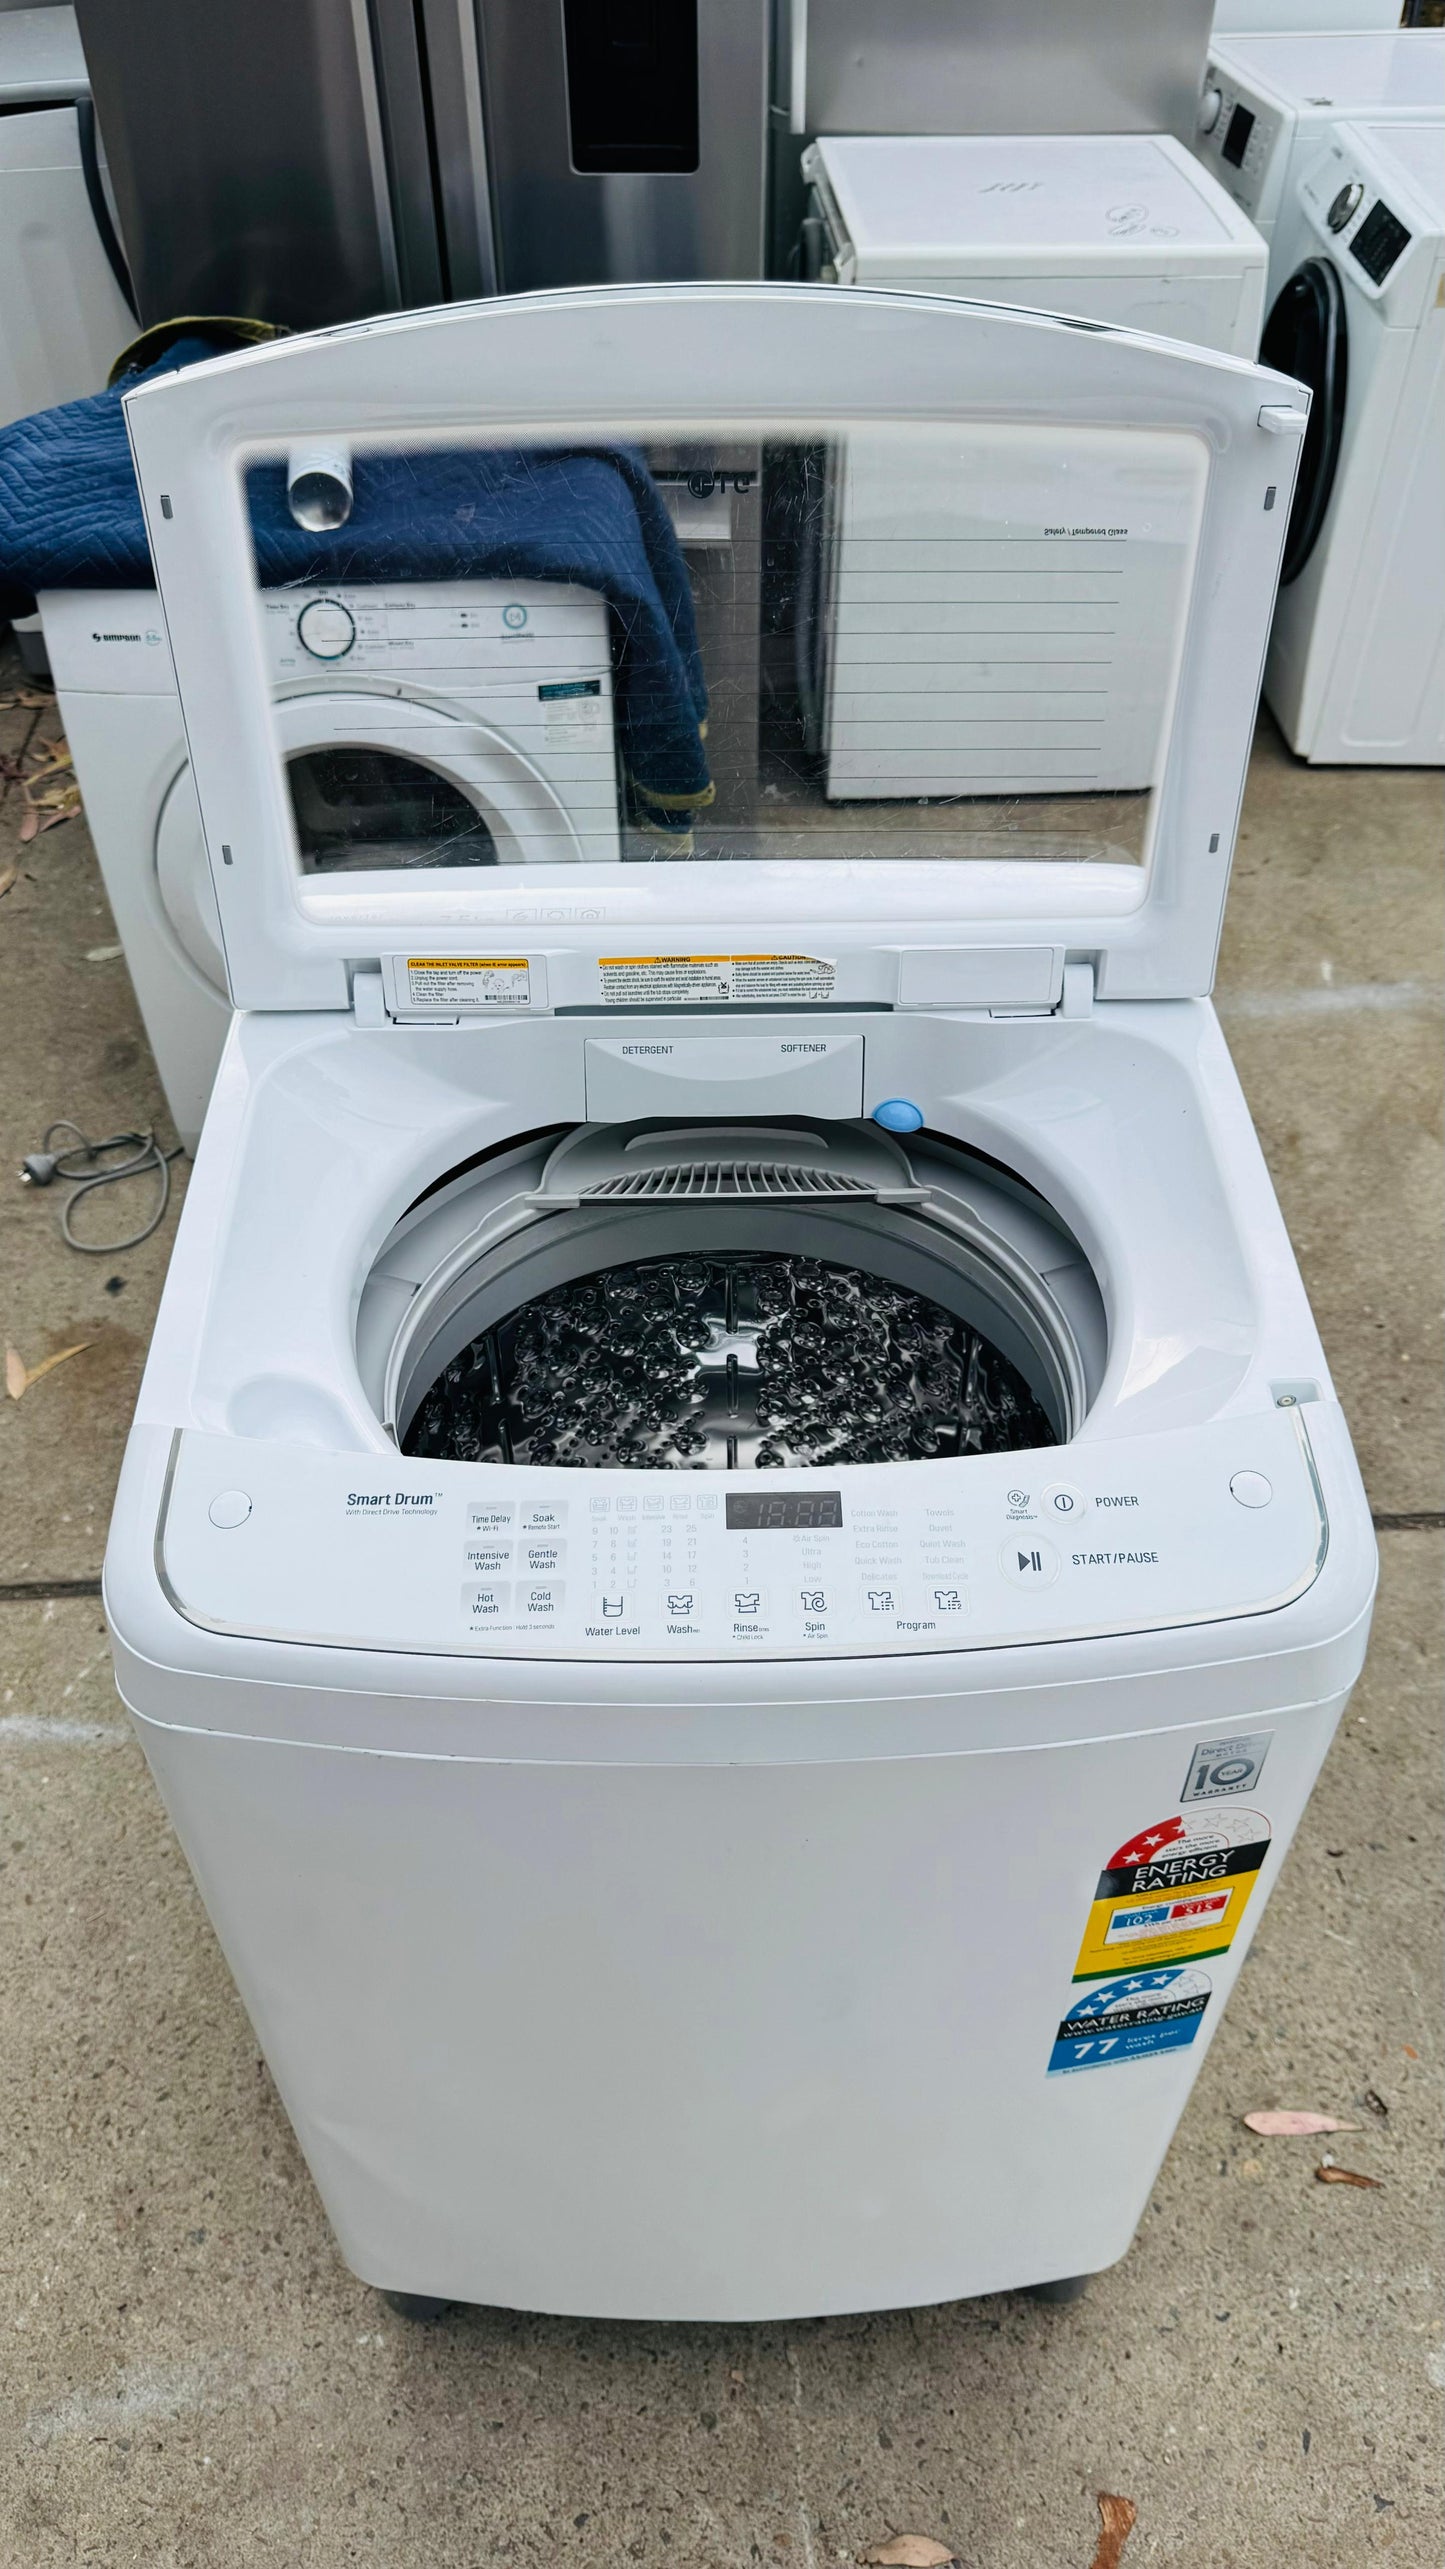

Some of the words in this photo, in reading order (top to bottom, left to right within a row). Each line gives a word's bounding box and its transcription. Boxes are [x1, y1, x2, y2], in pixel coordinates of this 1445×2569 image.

[622, 1045, 674, 1055] DETERGENT
[781, 1044, 826, 1053] SOFTENER
[347, 1493, 391, 1506] Smart
[1096, 1496, 1139, 1507] POWER
[402, 1508, 437, 1516] Technology
[877, 1509, 898, 1517] Wash
[925, 1508, 954, 1517] Towels
[472, 1515, 489, 1524] Time
[491, 1514, 511, 1524] Delay
[533, 1513, 555, 1523] Soak
[592, 1527, 598, 1535] 9
[610, 1526, 619, 1535] 10
[661, 1524, 672, 1533] 23
[686, 1524, 697, 1533] 25
[853, 1525, 875, 1533] Extra
[877, 1524, 898, 1532] Rinse
[929, 1524, 952, 1532] Duvet
[592, 1540, 598, 1549] 7
[610, 1540, 616, 1549] 8
[663, 1538, 672, 1547] 19
[688, 1537, 697, 1546] 21
[743, 1536, 748, 1544] 4
[856, 1540, 870, 1549] Eco
[872, 1540, 898, 1548] Cotton
[920, 1539, 940, 1548] Quiet
[943, 1539, 966, 1548] Wash
[468, 1551, 510, 1560] Intensive
[528, 1549, 557, 1559] Gentle
[663, 1551, 672, 1560] 14
[688, 1551, 696, 1559] 17
[743, 1550, 748, 1559] 3
[802, 1547, 821, 1556] Ultra
[592, 1553, 597, 1562] 5
[610, 1552, 616, 1561] 6
[855, 1556, 876, 1565] Quick
[879, 1555, 902, 1565] Wash
[925, 1555, 940, 1564] Tub
[941, 1555, 964, 1564] Clean
[1072, 1552, 1159, 1565] START/PAUSE
[475, 1561, 501, 1571] Wash
[530, 1560, 555, 1569] Wash
[663, 1564, 672, 1574] 10
[688, 1564, 697, 1573] 12
[744, 1563, 749, 1572] 2
[803, 1561, 821, 1571] High
[592, 1566, 597, 1576] 3
[610, 1566, 616, 1575] 4
[745, 1576, 748, 1585] 1
[804, 1575, 822, 1584] Low
[862, 1572, 897, 1581] Delicates
[593, 1580, 596, 1589] 1
[610, 1580, 616, 1589] 2
[664, 1579, 670, 1587] 3
[690, 1578, 695, 1587] 6
[478, 1593, 494, 1603] Hot
[531, 1591, 551, 1601] Cold
[473, 1604, 499, 1614] Wash
[528, 1602, 554, 1612] Wash
[667, 1624, 692, 1634] Wash
[734, 1623, 758, 1633] Rinse
[805, 1621, 825, 1633] Spin
[897, 1620, 936, 1632] Program
[585, 1627, 613, 1636] Water
[616, 1626, 640, 1636] Level
[817, 1632, 828, 1640] Spin
[1195, 1758, 1255, 1790] 10
[1221, 1768, 1243, 1777] YEAR
[1193, 1783, 1247, 1797] WARRANTY
[1135, 1850, 1235, 1880] ENERGY
[1132, 1864, 1228, 1893] RATING
[1068, 2012, 1130, 2032] WATER
[1137, 1996, 1205, 2019] RATING
[1074, 2037, 1119, 2060] 77
